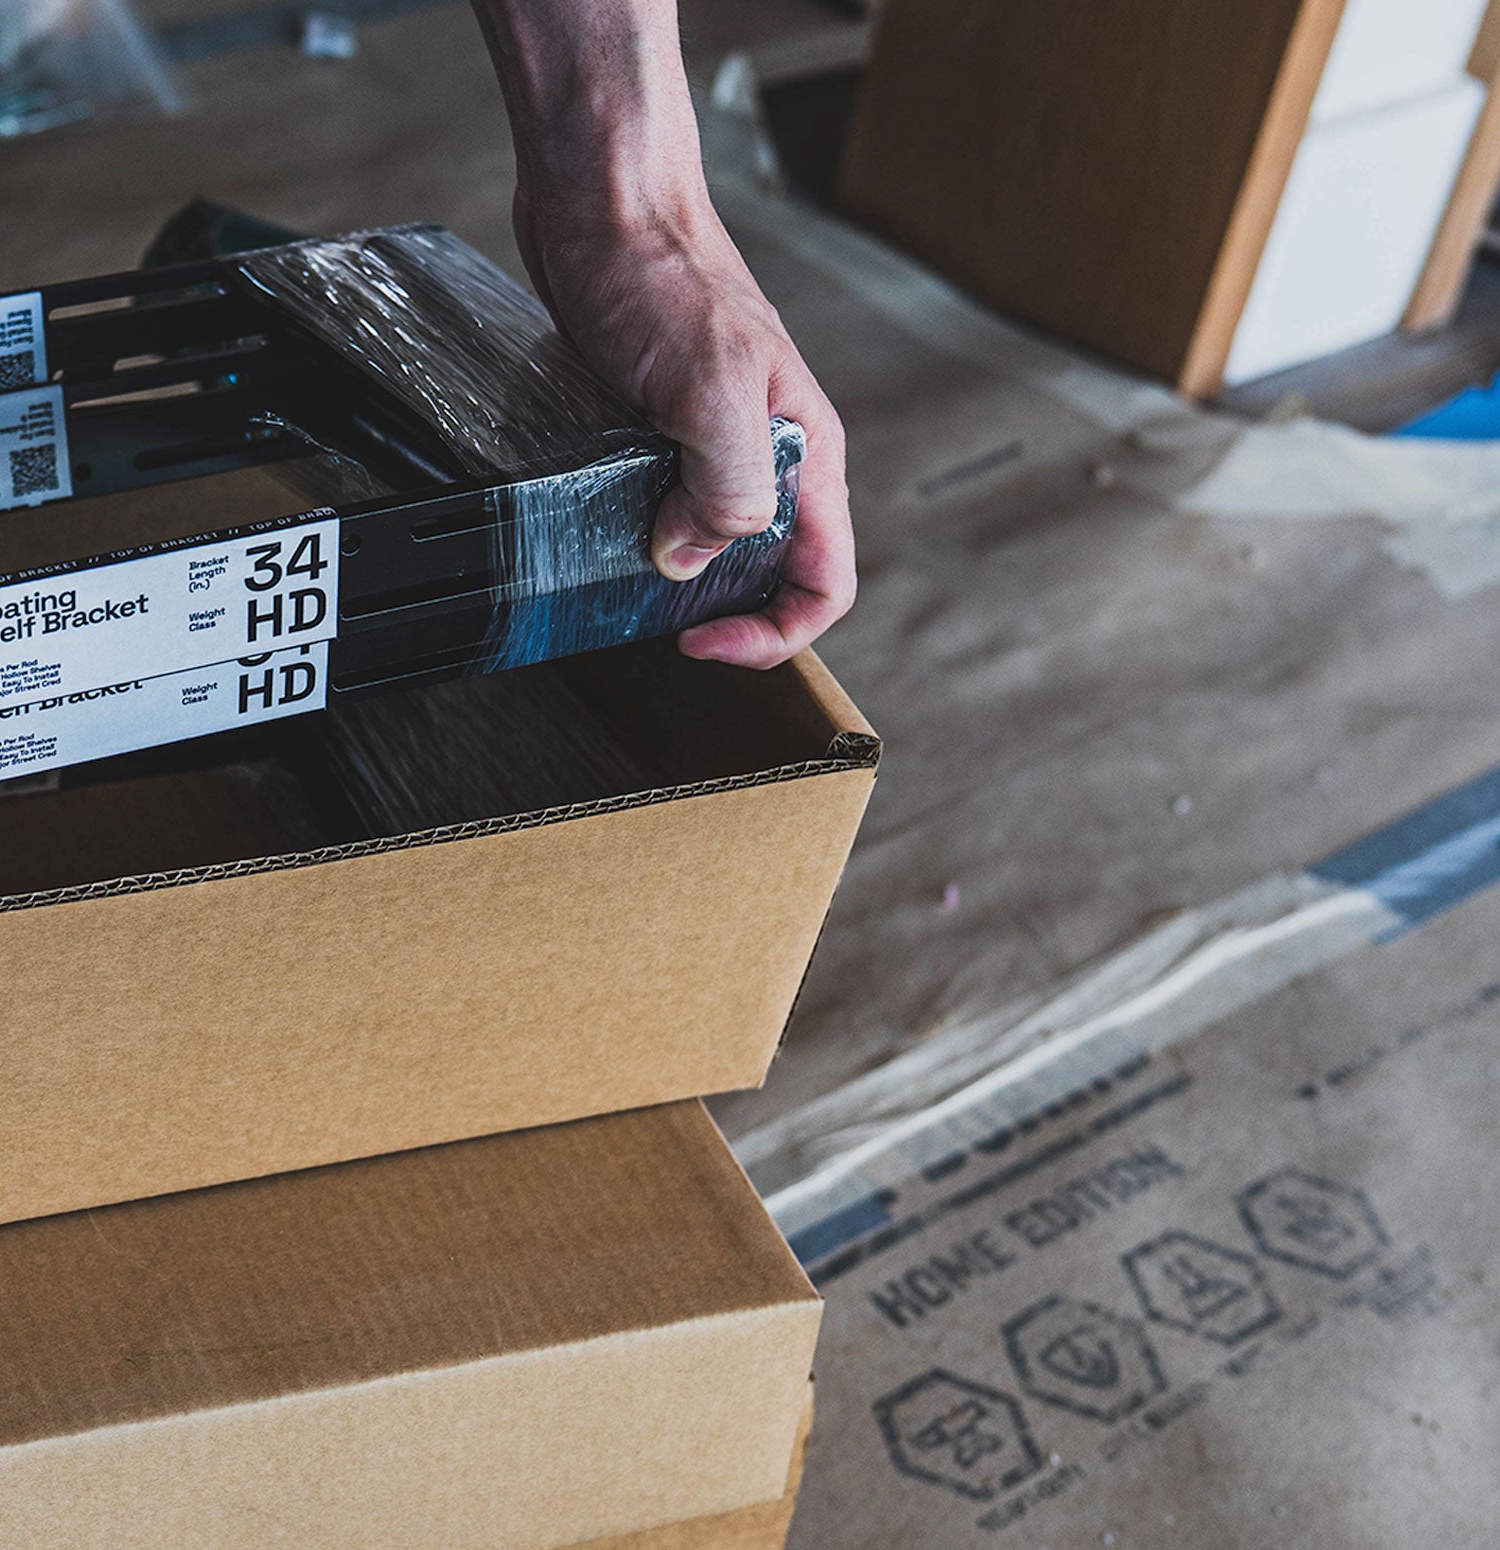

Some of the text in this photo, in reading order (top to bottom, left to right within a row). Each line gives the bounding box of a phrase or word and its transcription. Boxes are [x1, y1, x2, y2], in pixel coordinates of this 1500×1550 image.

[18, 559, 78, 578] BRACKET
[109, 548, 135, 560] TOP
[137, 544, 155, 554] OF
[159, 531, 219, 550] BRACKET
[248, 519, 273, 532] TOP
[276, 515, 293, 526] OF
[189, 555, 228, 570] Bracket
[243, 532, 327, 591] 34
[188, 565, 225, 582] Length
[188, 578, 210, 593] (in.)
[41, 593, 148, 634] Bracket
[188, 607, 225, 625] Weight
[247, 587, 326, 642] HD
[188, 620, 216, 631] Class
[0, 670, 28, 680] Hollow
[29, 663, 61, 674] Shelves
[21, 659, 38, 668] Rod
[1, 679, 21, 688] Easy
[33, 670, 58, 681] Install
[14, 682, 40, 693] Street
[41, 677, 61, 687] Cred
[238, 661, 316, 714] HD
[181, 682, 217, 696] Weight
[181, 692, 208, 705] Class
[18, 733, 34, 742] Rod
[26, 736, 57, 747] Shelves
[0, 752, 18, 760] Easy
[30, 743, 54, 753] Install
[11, 754, 36, 765] Street
[37, 749, 56, 759] Cred
[867, 1145, 1186, 1329] HOME EDITION
